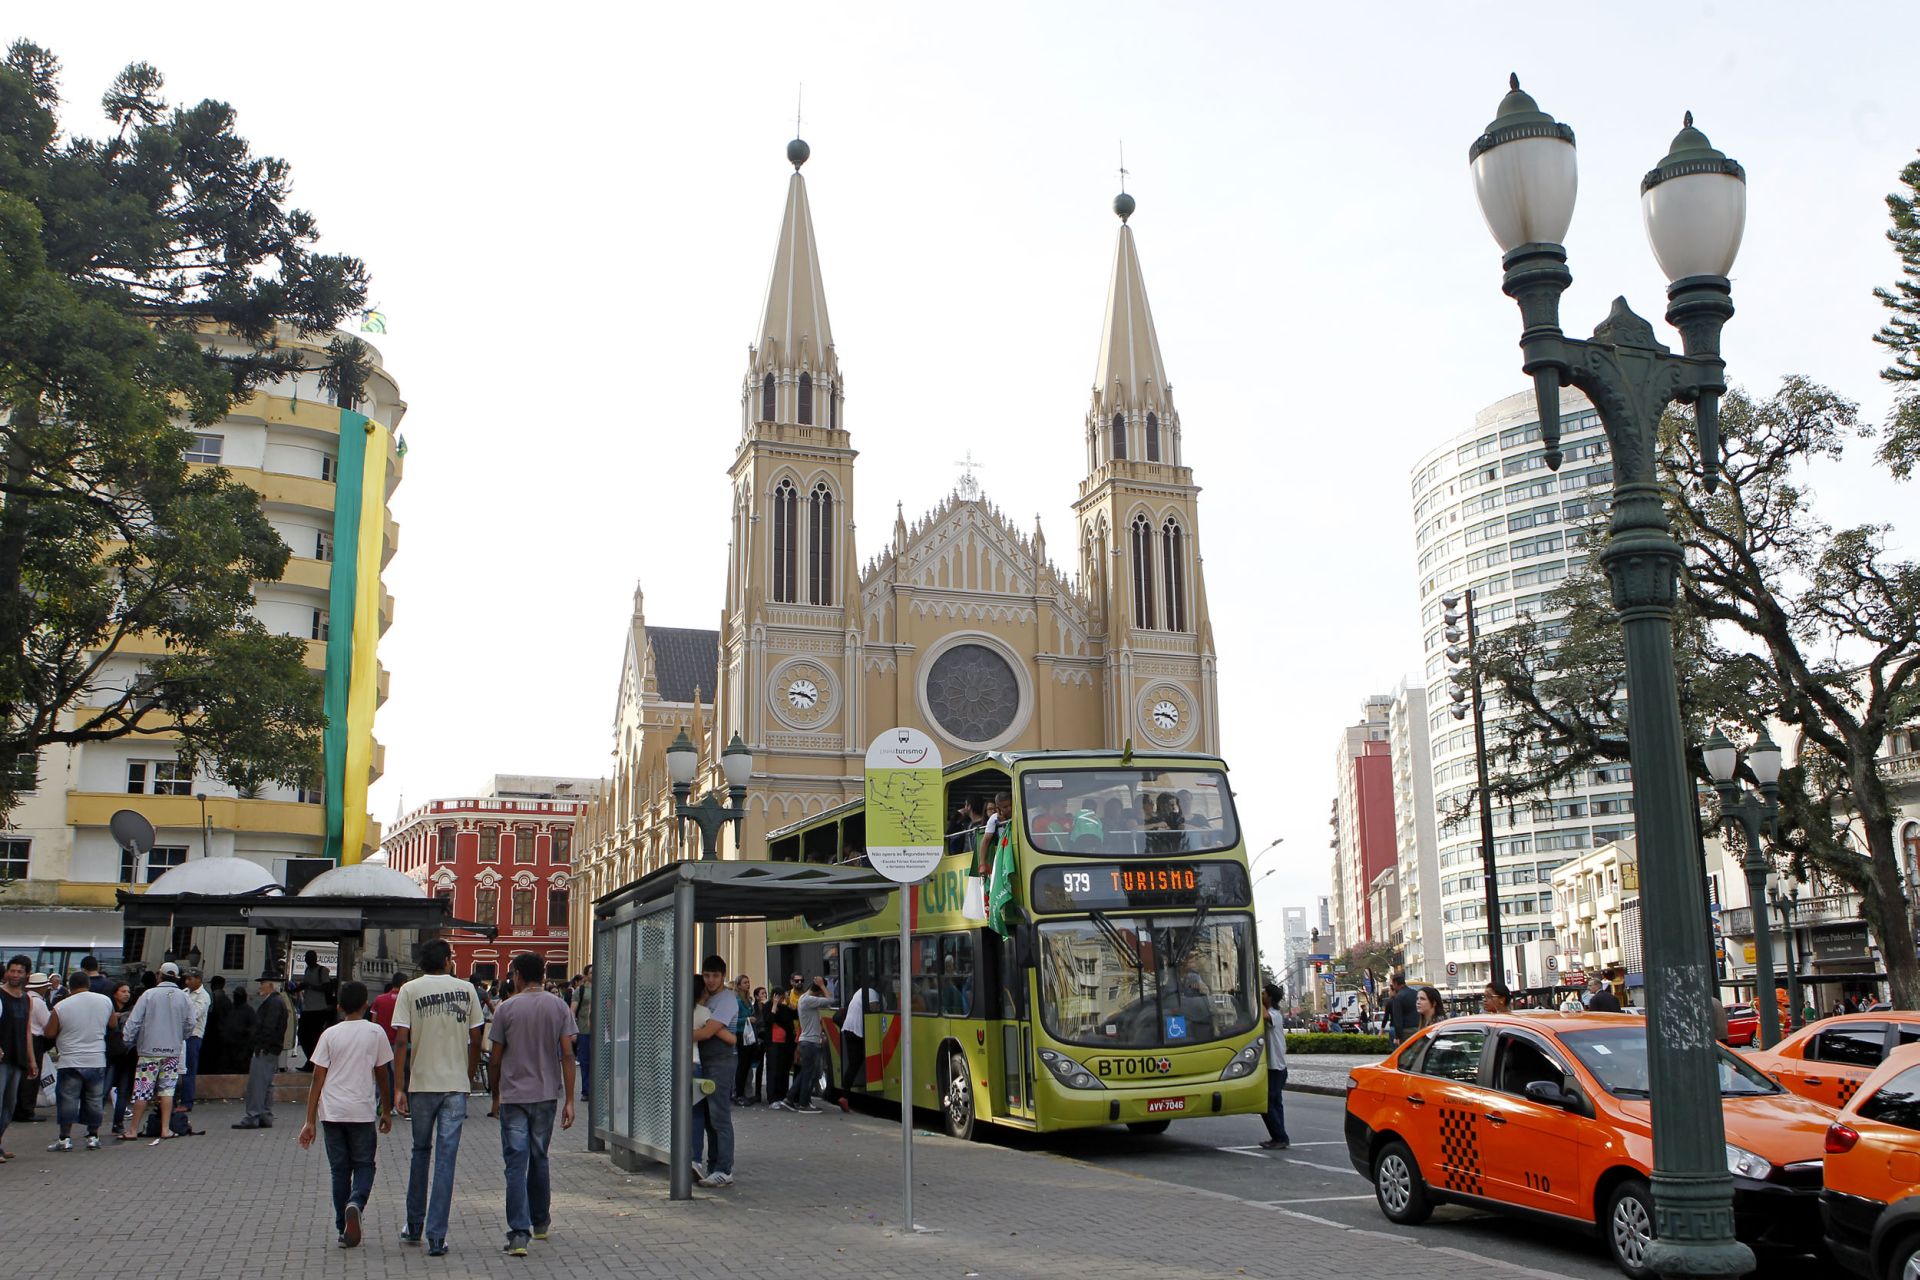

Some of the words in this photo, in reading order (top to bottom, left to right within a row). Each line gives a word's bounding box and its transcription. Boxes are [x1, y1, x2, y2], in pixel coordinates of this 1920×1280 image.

[1063, 872, 1090, 893] 979
[1110, 869, 1195, 892] TURISMO
[1567, 1002, 1581, 1011] TAXI
[1098, 1057, 1156, 1076] BT010
[1525, 1171, 1550, 1193] 110
